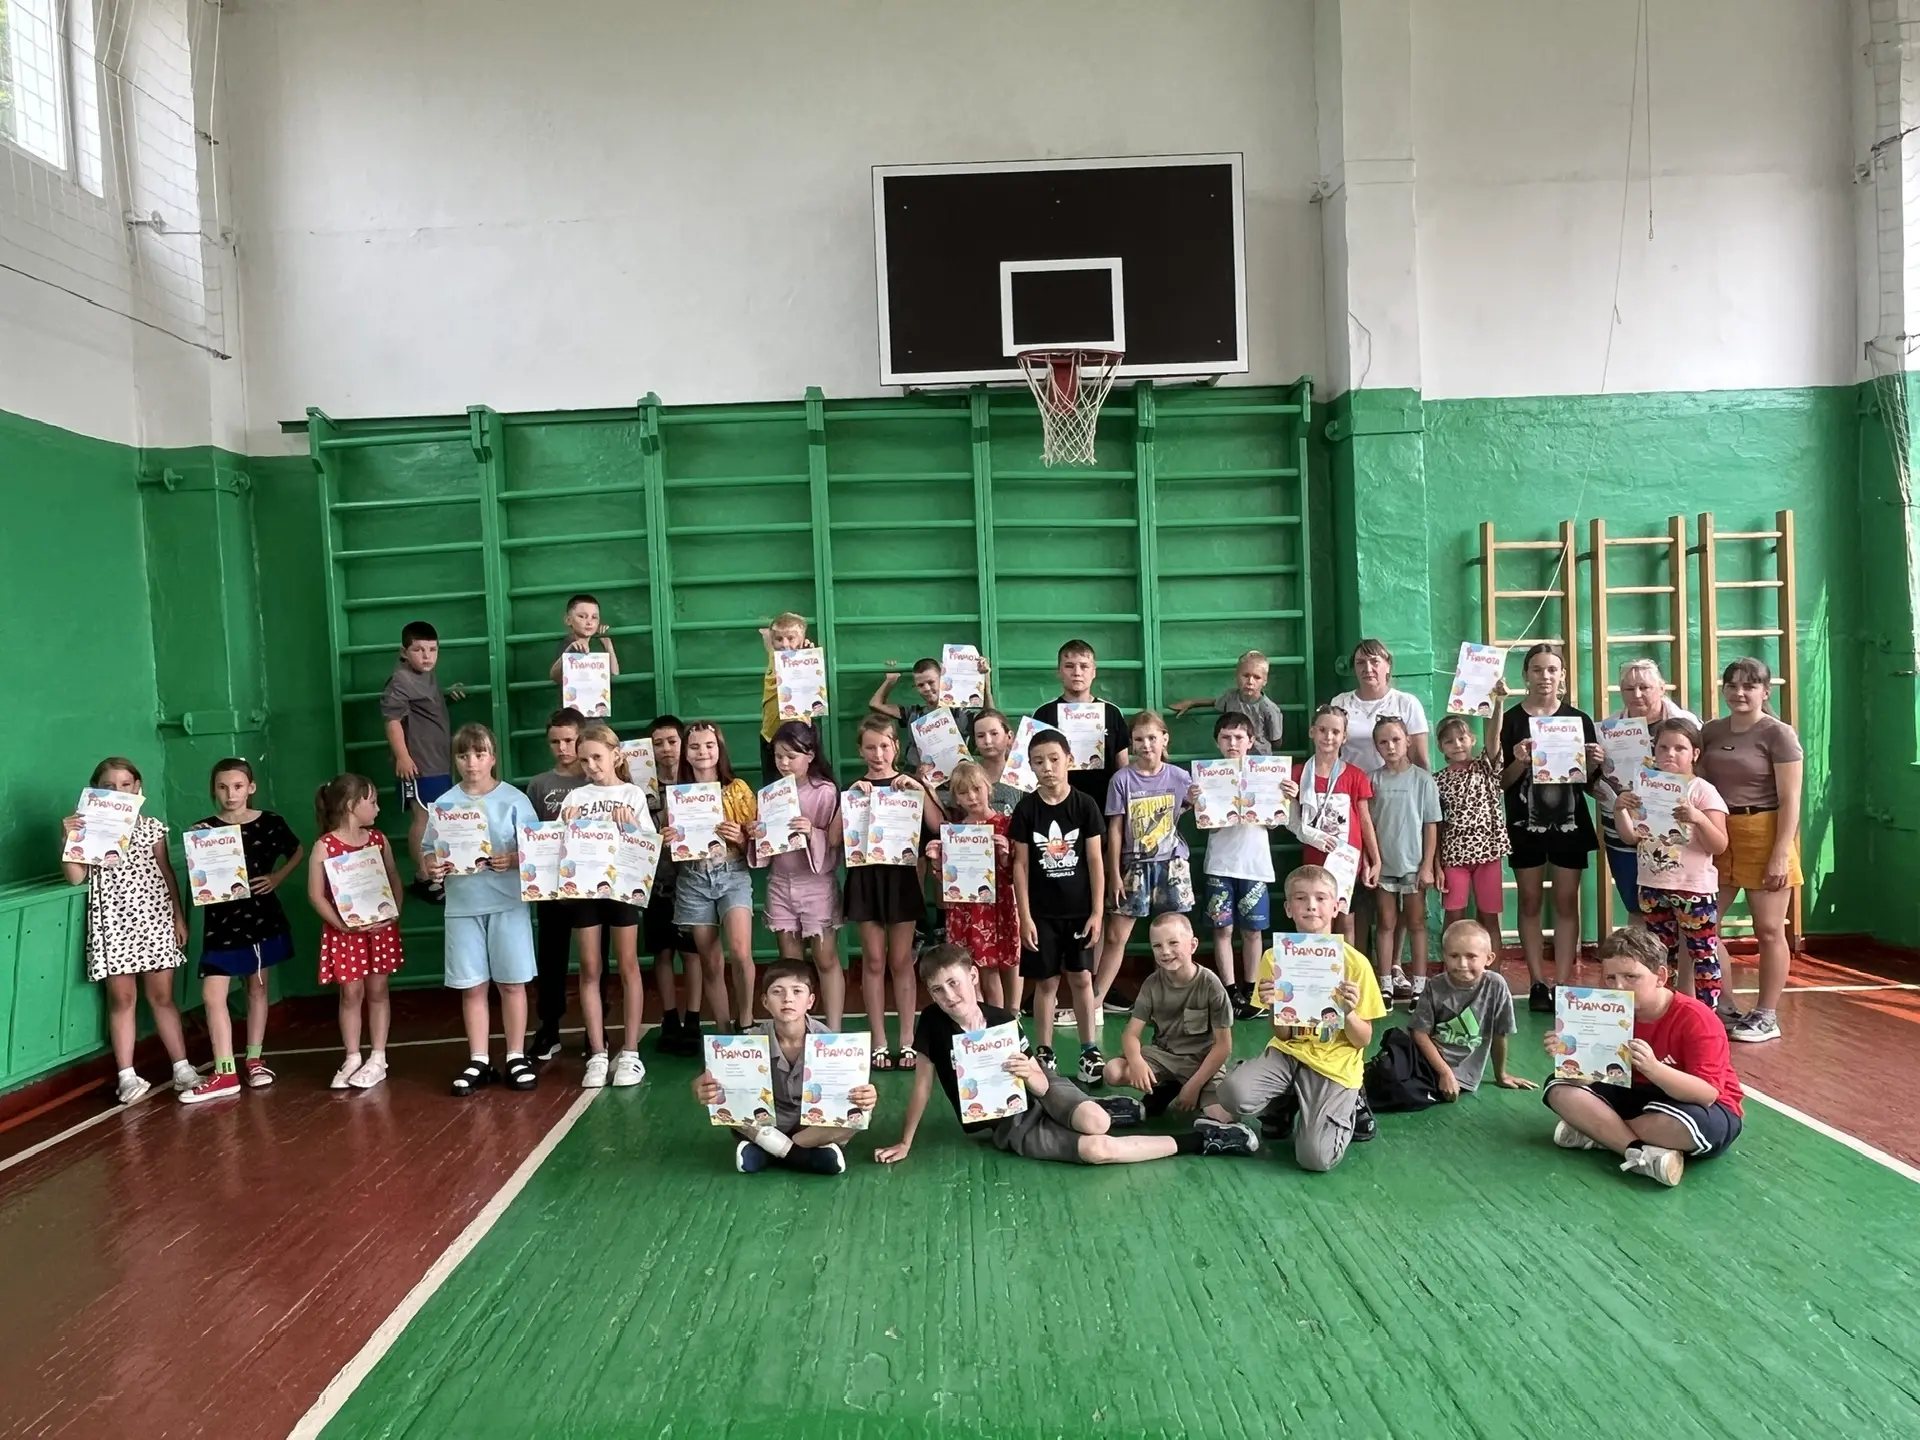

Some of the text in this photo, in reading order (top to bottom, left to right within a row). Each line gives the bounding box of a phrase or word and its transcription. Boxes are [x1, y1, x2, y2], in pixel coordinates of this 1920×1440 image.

[569, 658, 606, 670] ГРАМОТА
[782, 655, 820, 668] ГРАМОТА
[1466, 651, 1501, 665] ГРАМОТА
[1064, 707, 1101, 720] ГРАМОТА
[916, 717, 951, 735] ГРАМОТА
[1538, 722, 1578, 734] ГРАМОТА
[1603, 726, 1643, 738] ГРАМОТА
[1198, 767, 1236, 777] ГРАМОТА
[1249, 763, 1287, 775] ГРАМОТА
[1641, 777, 1682, 793] ГРАМОТА
[673, 792, 716, 806] ГРАМОТА
[763, 787, 793, 803] ГРАМОТА
[86, 796, 134, 814] ГРАМОТА
[878, 796, 919, 809] ГРАМОТА
[436, 810, 482, 822] ГРАМОТА
[571, 829, 615, 841] ГРАМОТА
[948, 832, 989, 844] ГРАМОТА
[192, 834, 238, 850] ГРАМОТА
[622, 834, 656, 852] ГРАМОТА
[335, 858, 379, 874] ГРАМОТА
[1284, 945, 1337, 957] ГРАМОТА
[1567, 999, 1626, 1014] ГРАМОТА
[816, 1046, 865, 1058] ГРАМОТА
[965, 1037, 1014, 1055] ГРАМОТА
[714, 1047, 763, 1060] ГРАМОТА
